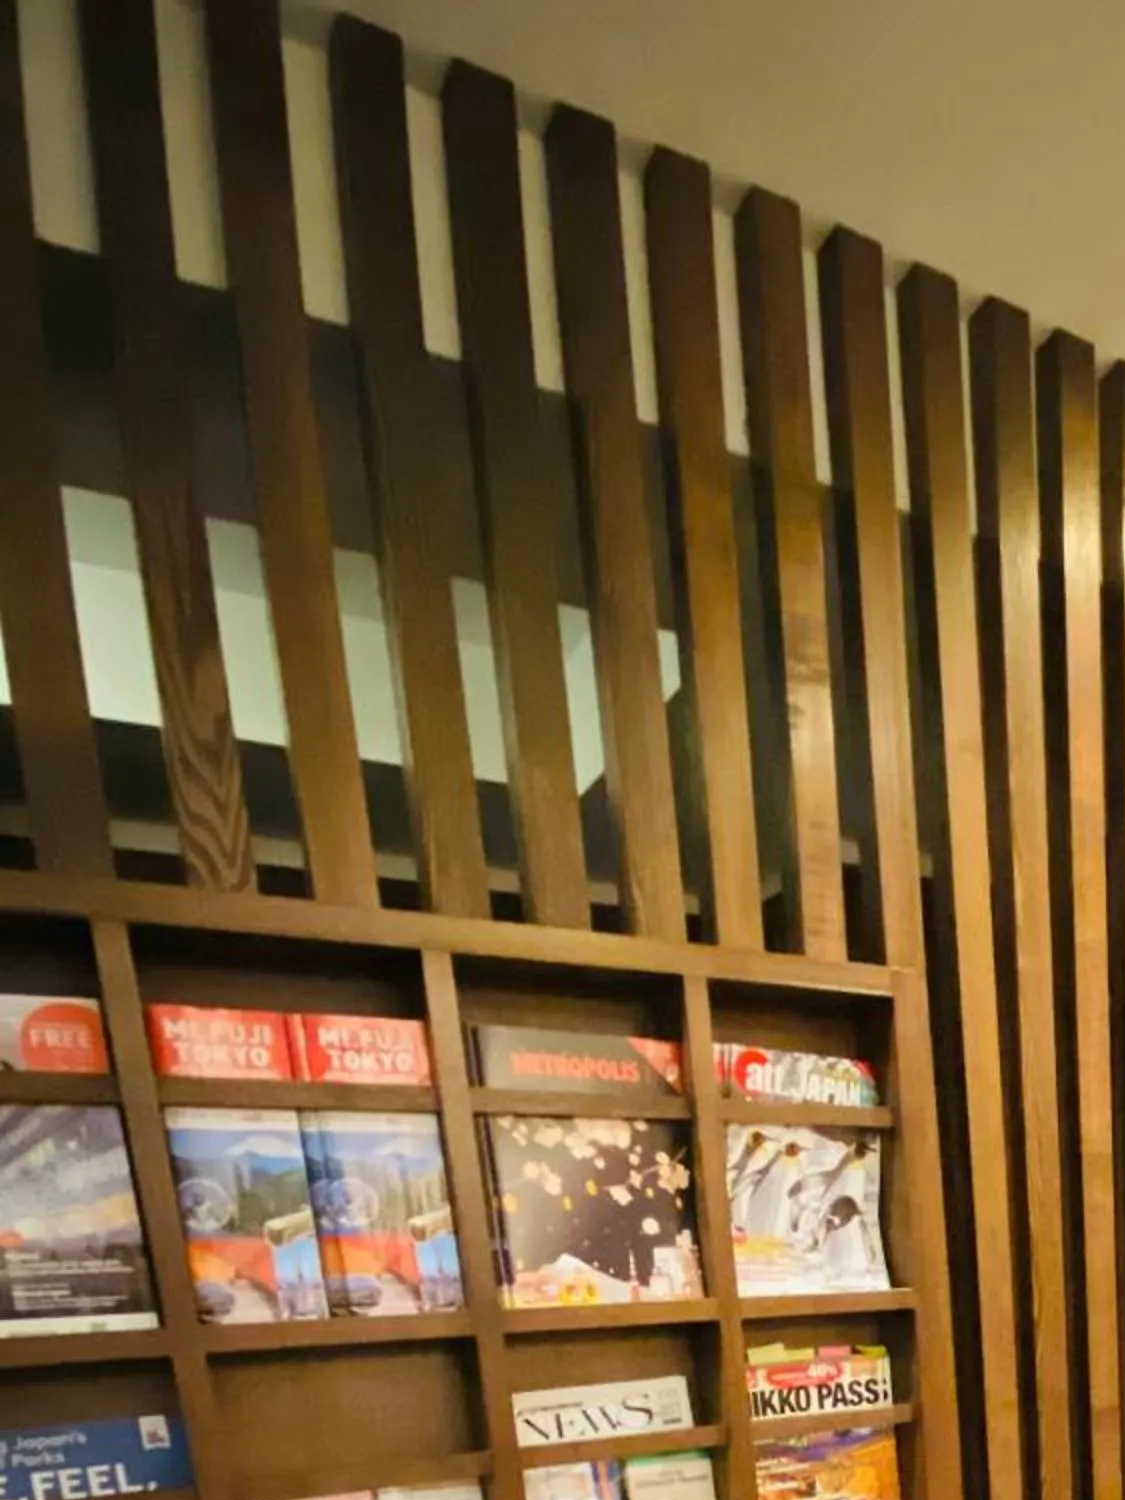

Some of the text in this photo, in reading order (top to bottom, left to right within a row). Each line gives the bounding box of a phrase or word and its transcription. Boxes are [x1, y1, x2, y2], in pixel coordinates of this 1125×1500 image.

[171, 1041, 271, 1070] TOKYO
[326, 1047, 414, 1073] TOKYO
[509, 1050, 641, 1084] METROPOLIS
[752, 1377, 881, 1417] IKKO PASS
